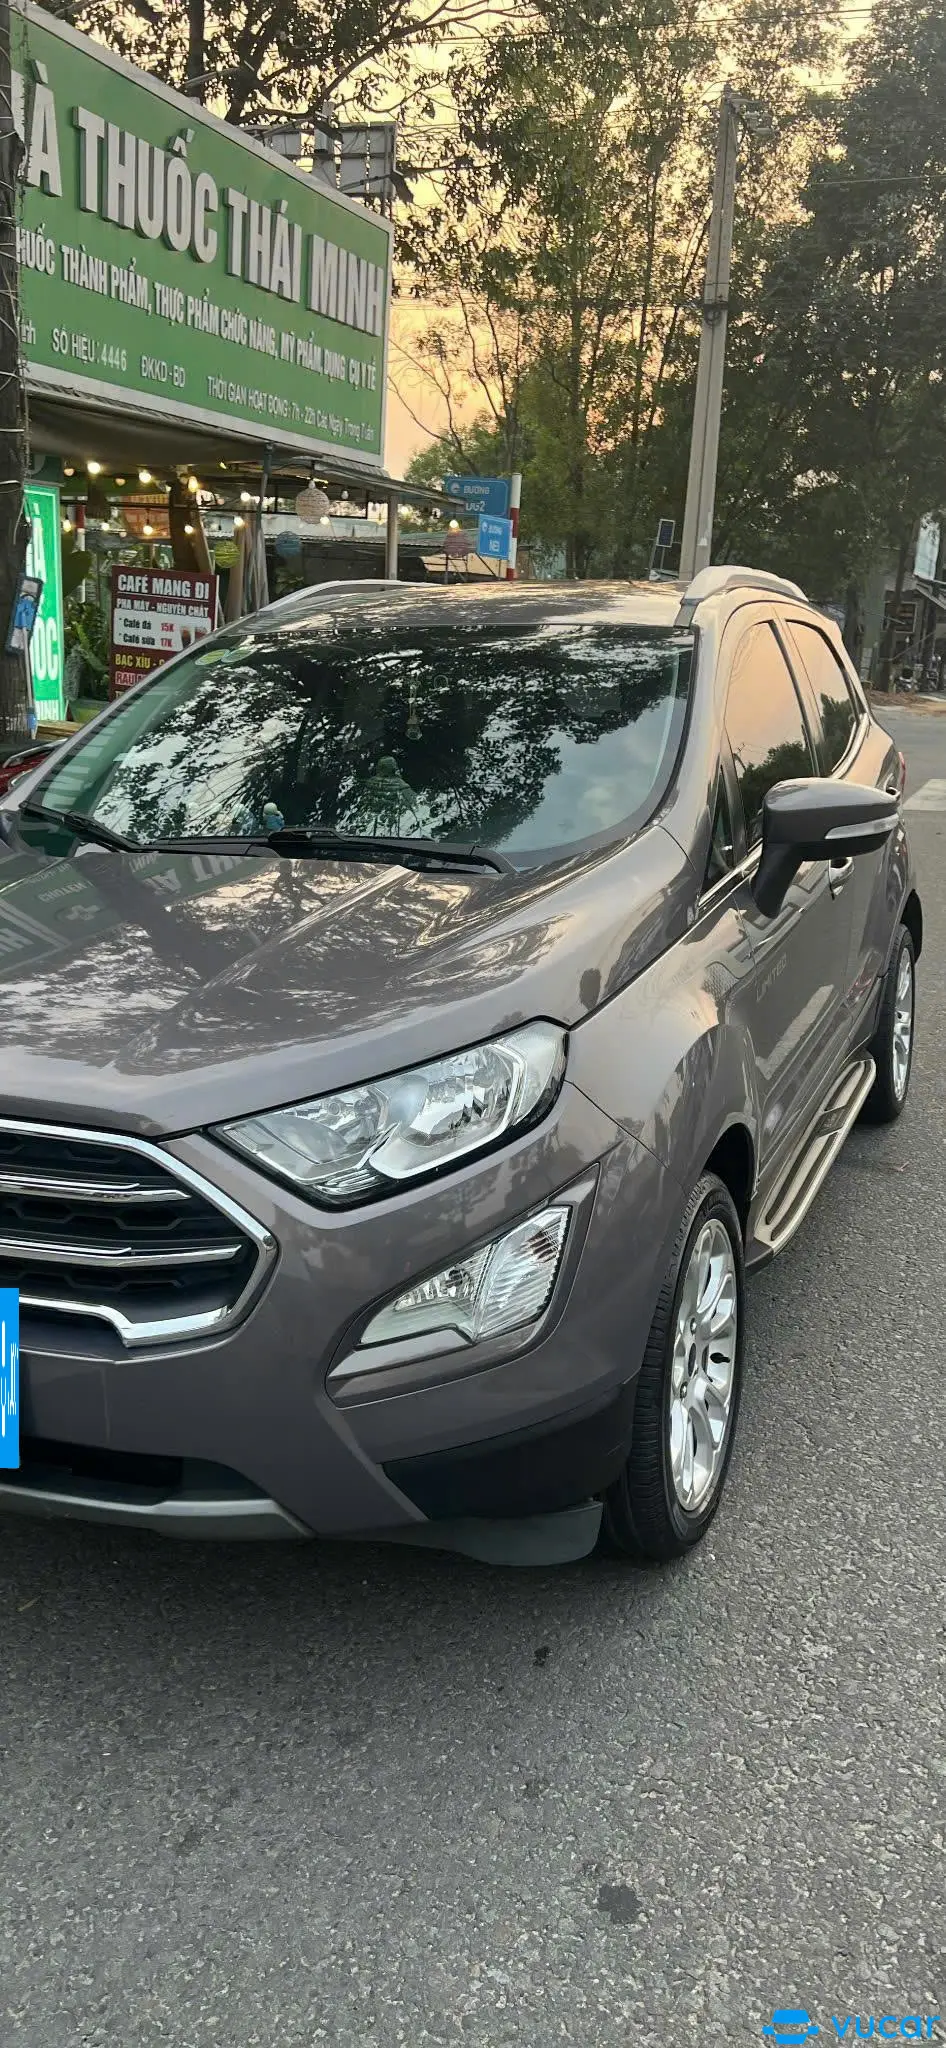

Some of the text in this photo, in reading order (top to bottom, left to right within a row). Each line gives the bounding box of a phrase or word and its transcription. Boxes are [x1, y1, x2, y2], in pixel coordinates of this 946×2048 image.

[72, 106, 218, 263] THUỐC
[223, 186, 302, 303] THÁI
[307, 233, 384, 336] MINH
[61, 244, 107, 294] THÀNH
[153, 281, 184, 326] THỰC
[186, 288, 219, 336] PHẨM
[221, 308, 247, 345] CHỨC
[118, 574, 148, 593] CAFÉ
[152, 578, 191, 598] MANG
[116, 598, 131, 610] PHA
[123, 618, 140, 629] Café
[123, 633, 140, 643] Café
[115, 653, 134, 669] BẠC
